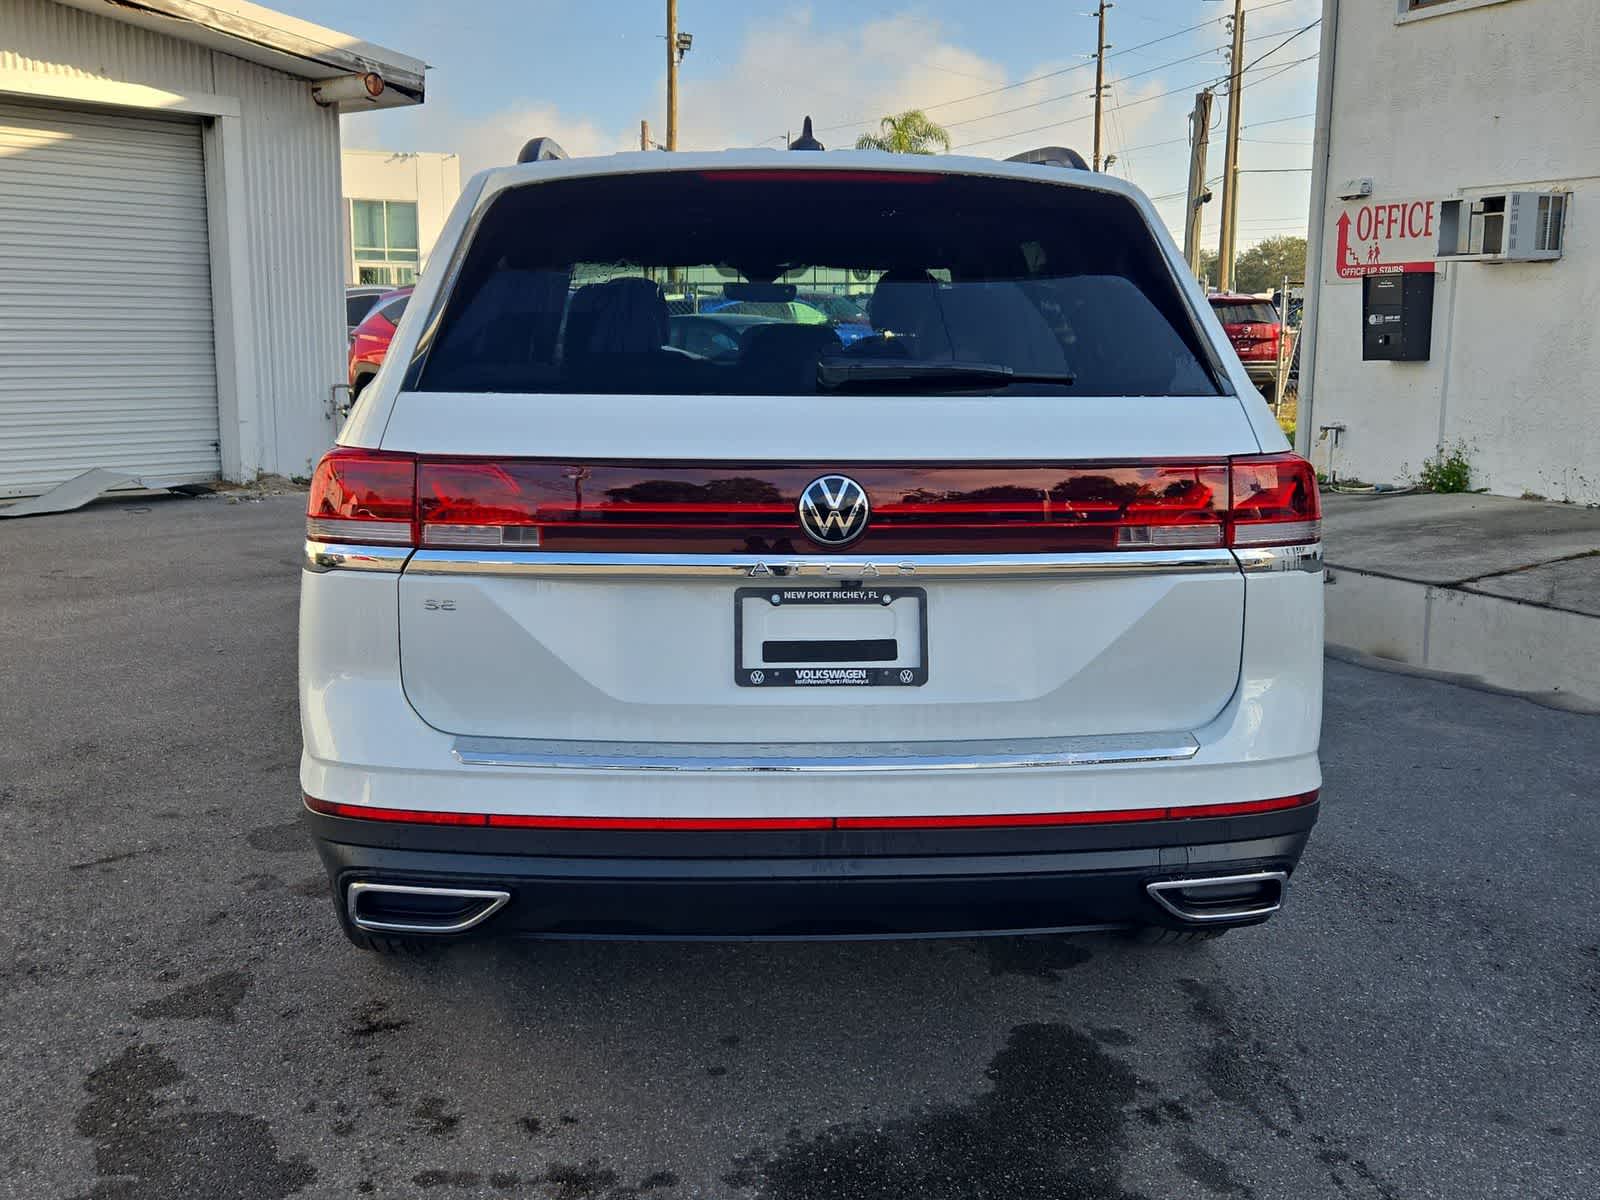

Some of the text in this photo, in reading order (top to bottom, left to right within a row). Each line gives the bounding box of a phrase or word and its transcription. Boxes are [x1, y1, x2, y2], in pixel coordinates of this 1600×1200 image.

[1357, 202, 1434, 241] OFFICE
[1342, 265, 1404, 276] OFFICE UP STAIRS
[750, 561, 915, 577] ATLAS
[784, 591, 879, 600] NEW PORT RICHEY, FL
[424, 599, 457, 611] SE
[795, 670, 866, 679] VOLKSWAGEN
